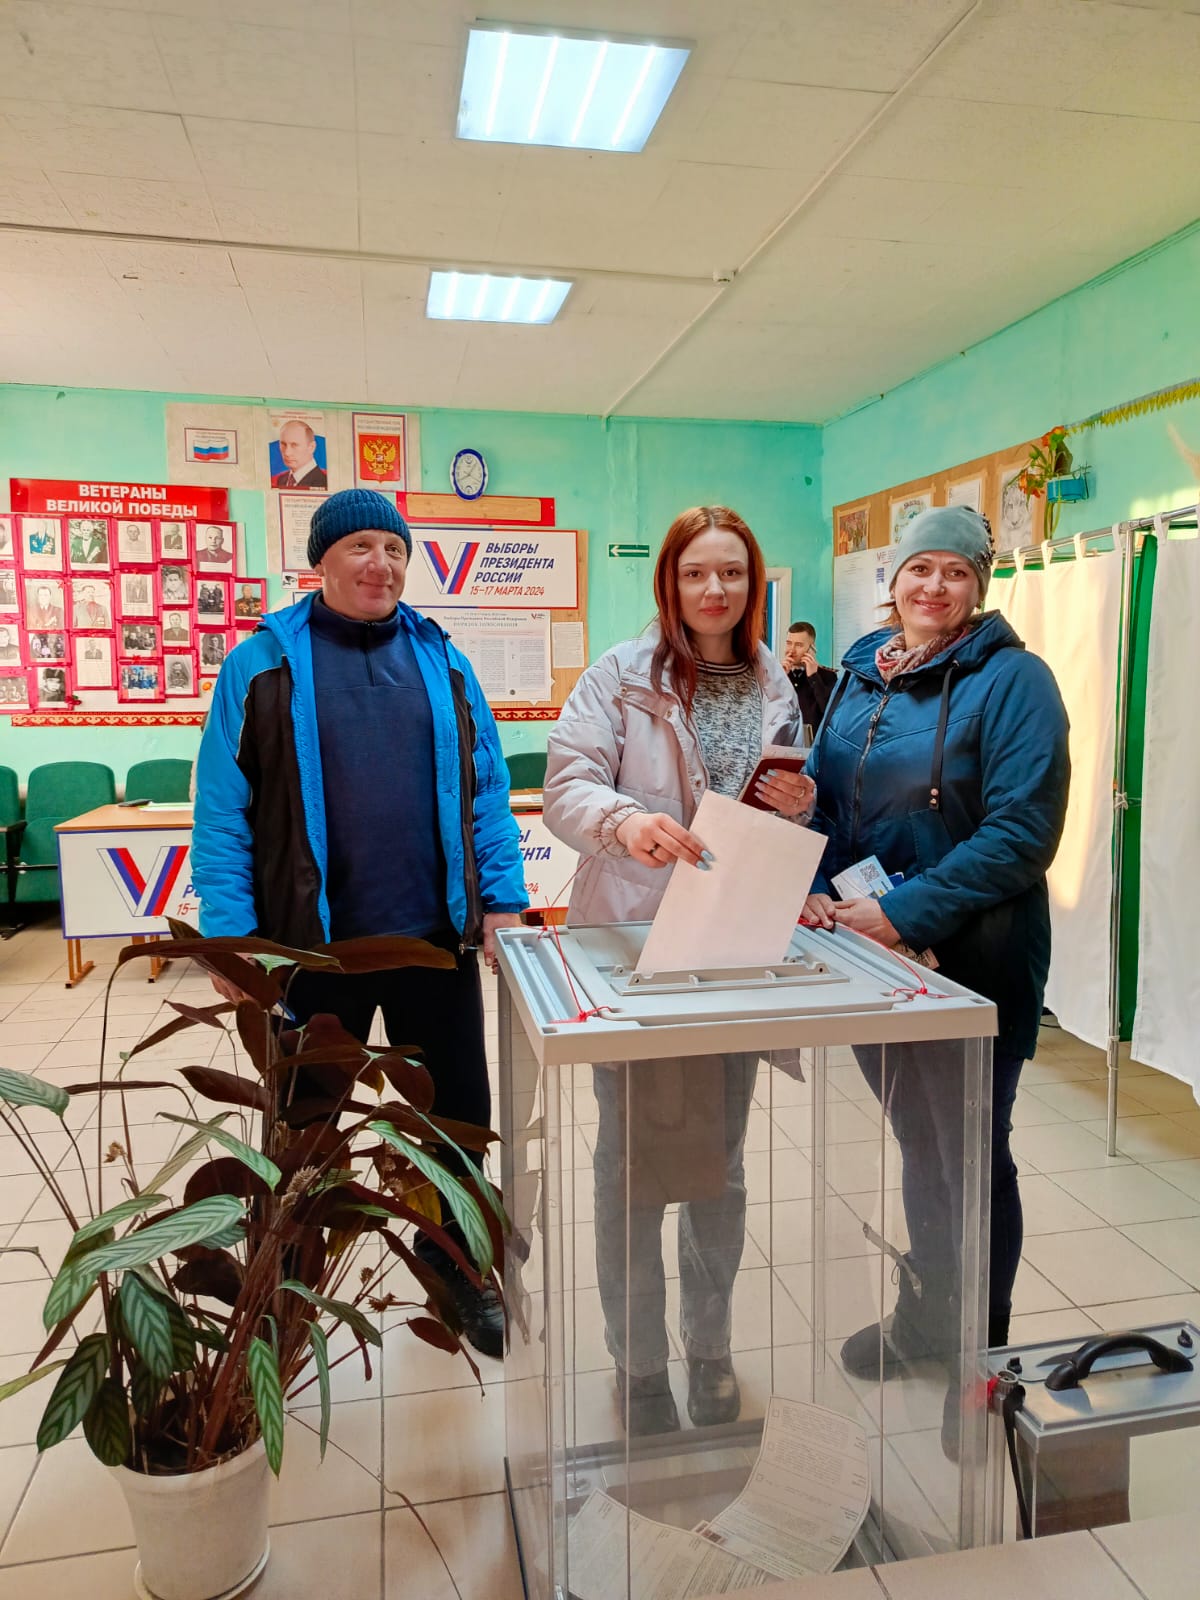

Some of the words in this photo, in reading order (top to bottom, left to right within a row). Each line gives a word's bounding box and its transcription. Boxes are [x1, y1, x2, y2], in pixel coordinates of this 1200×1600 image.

[78, 484, 167, 500] ВЕТЕРАНЫ
[46, 499, 123, 514] ВЕЛИКОЙ
[128, 502, 198, 518] ПОБЕДЫ
[485, 542, 539, 554] ВЫБОРЫ
[480, 557, 555, 570] ПРЕЗИДЕНТА
[474, 571, 523, 583] РОССИИ
[494, 586, 522, 596] МАРТА
[524, 586, 545, 596] 2024
